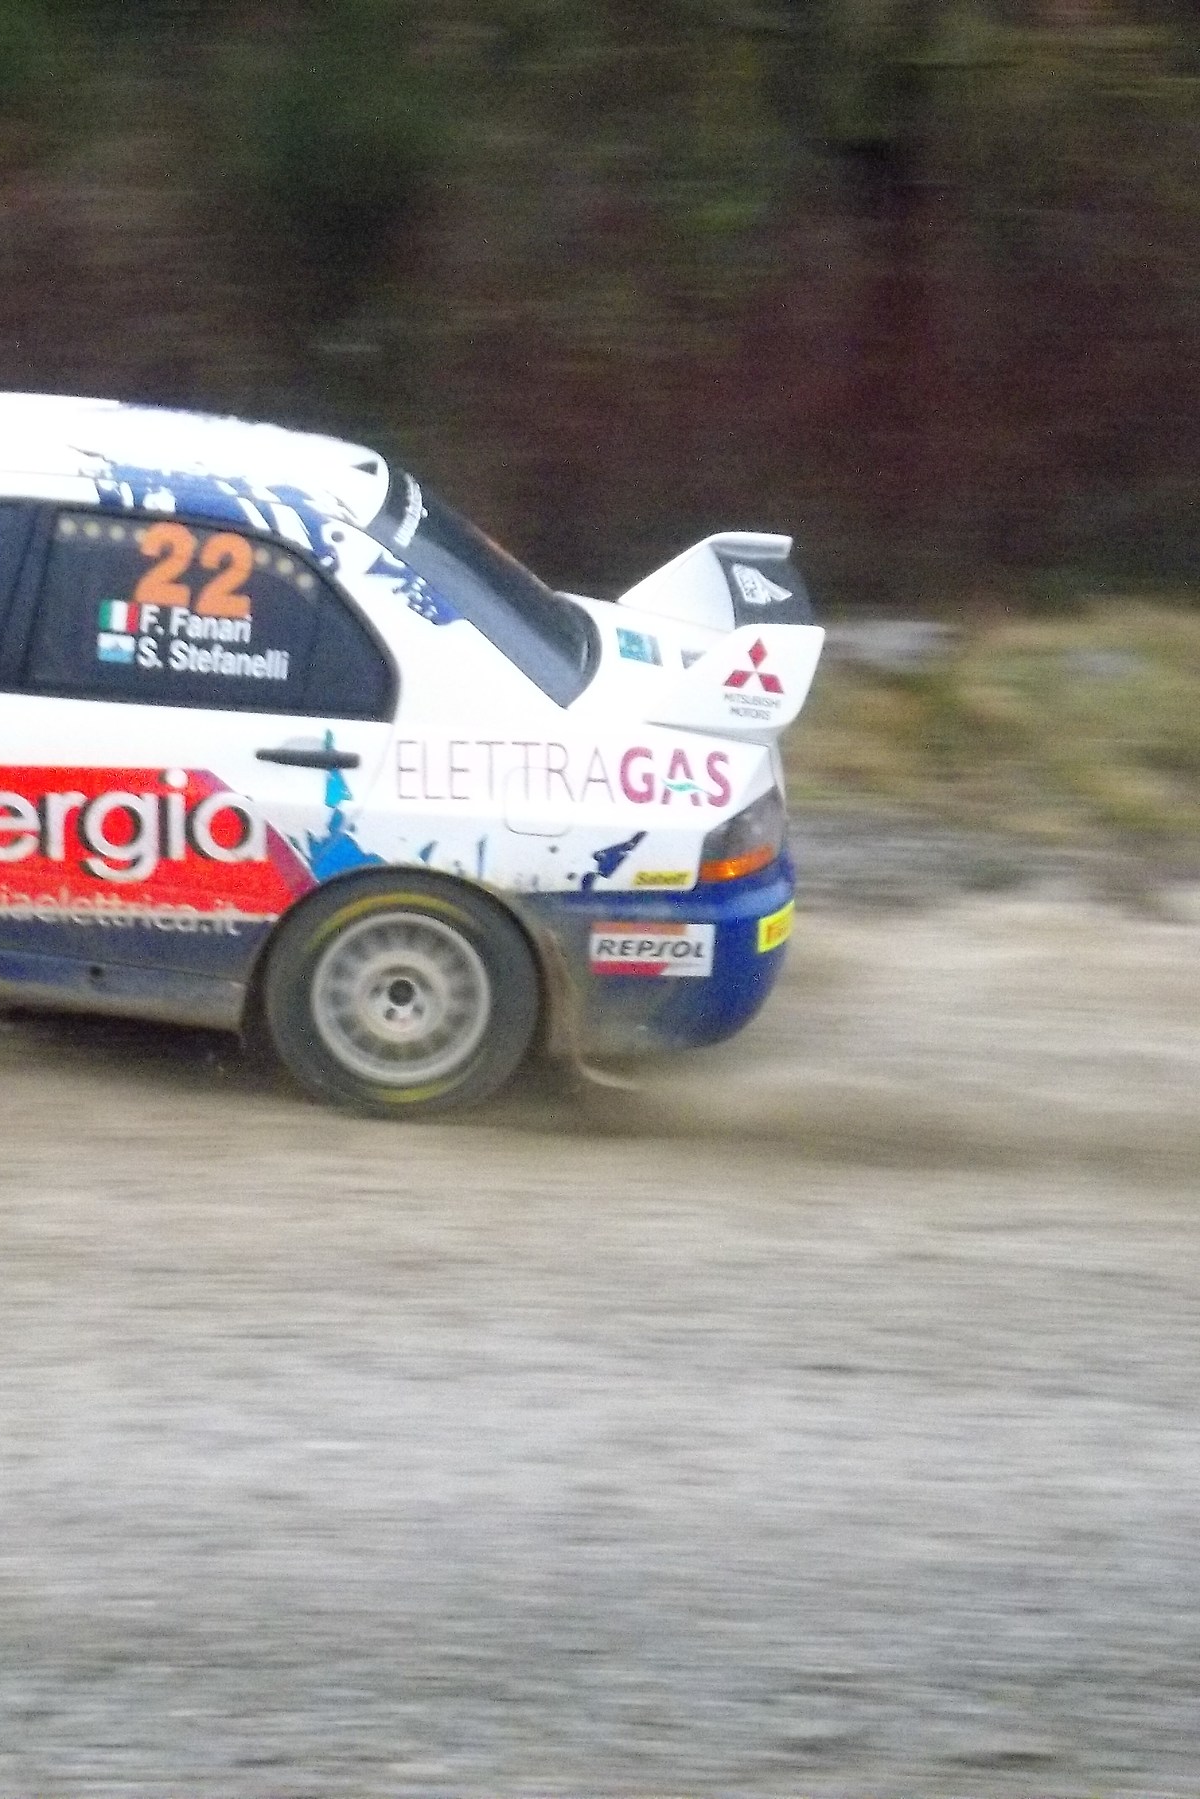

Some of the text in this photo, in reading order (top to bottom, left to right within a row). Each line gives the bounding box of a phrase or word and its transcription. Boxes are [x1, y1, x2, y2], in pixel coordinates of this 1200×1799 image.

[135, 521, 254, 619] 22
[140, 604, 253, 644] F. Fanari
[137, 635, 289, 681] S. Stefanelli
[396, 739, 732, 809] ELETTRAGAS
[595, 938, 705, 960] REPSOL
